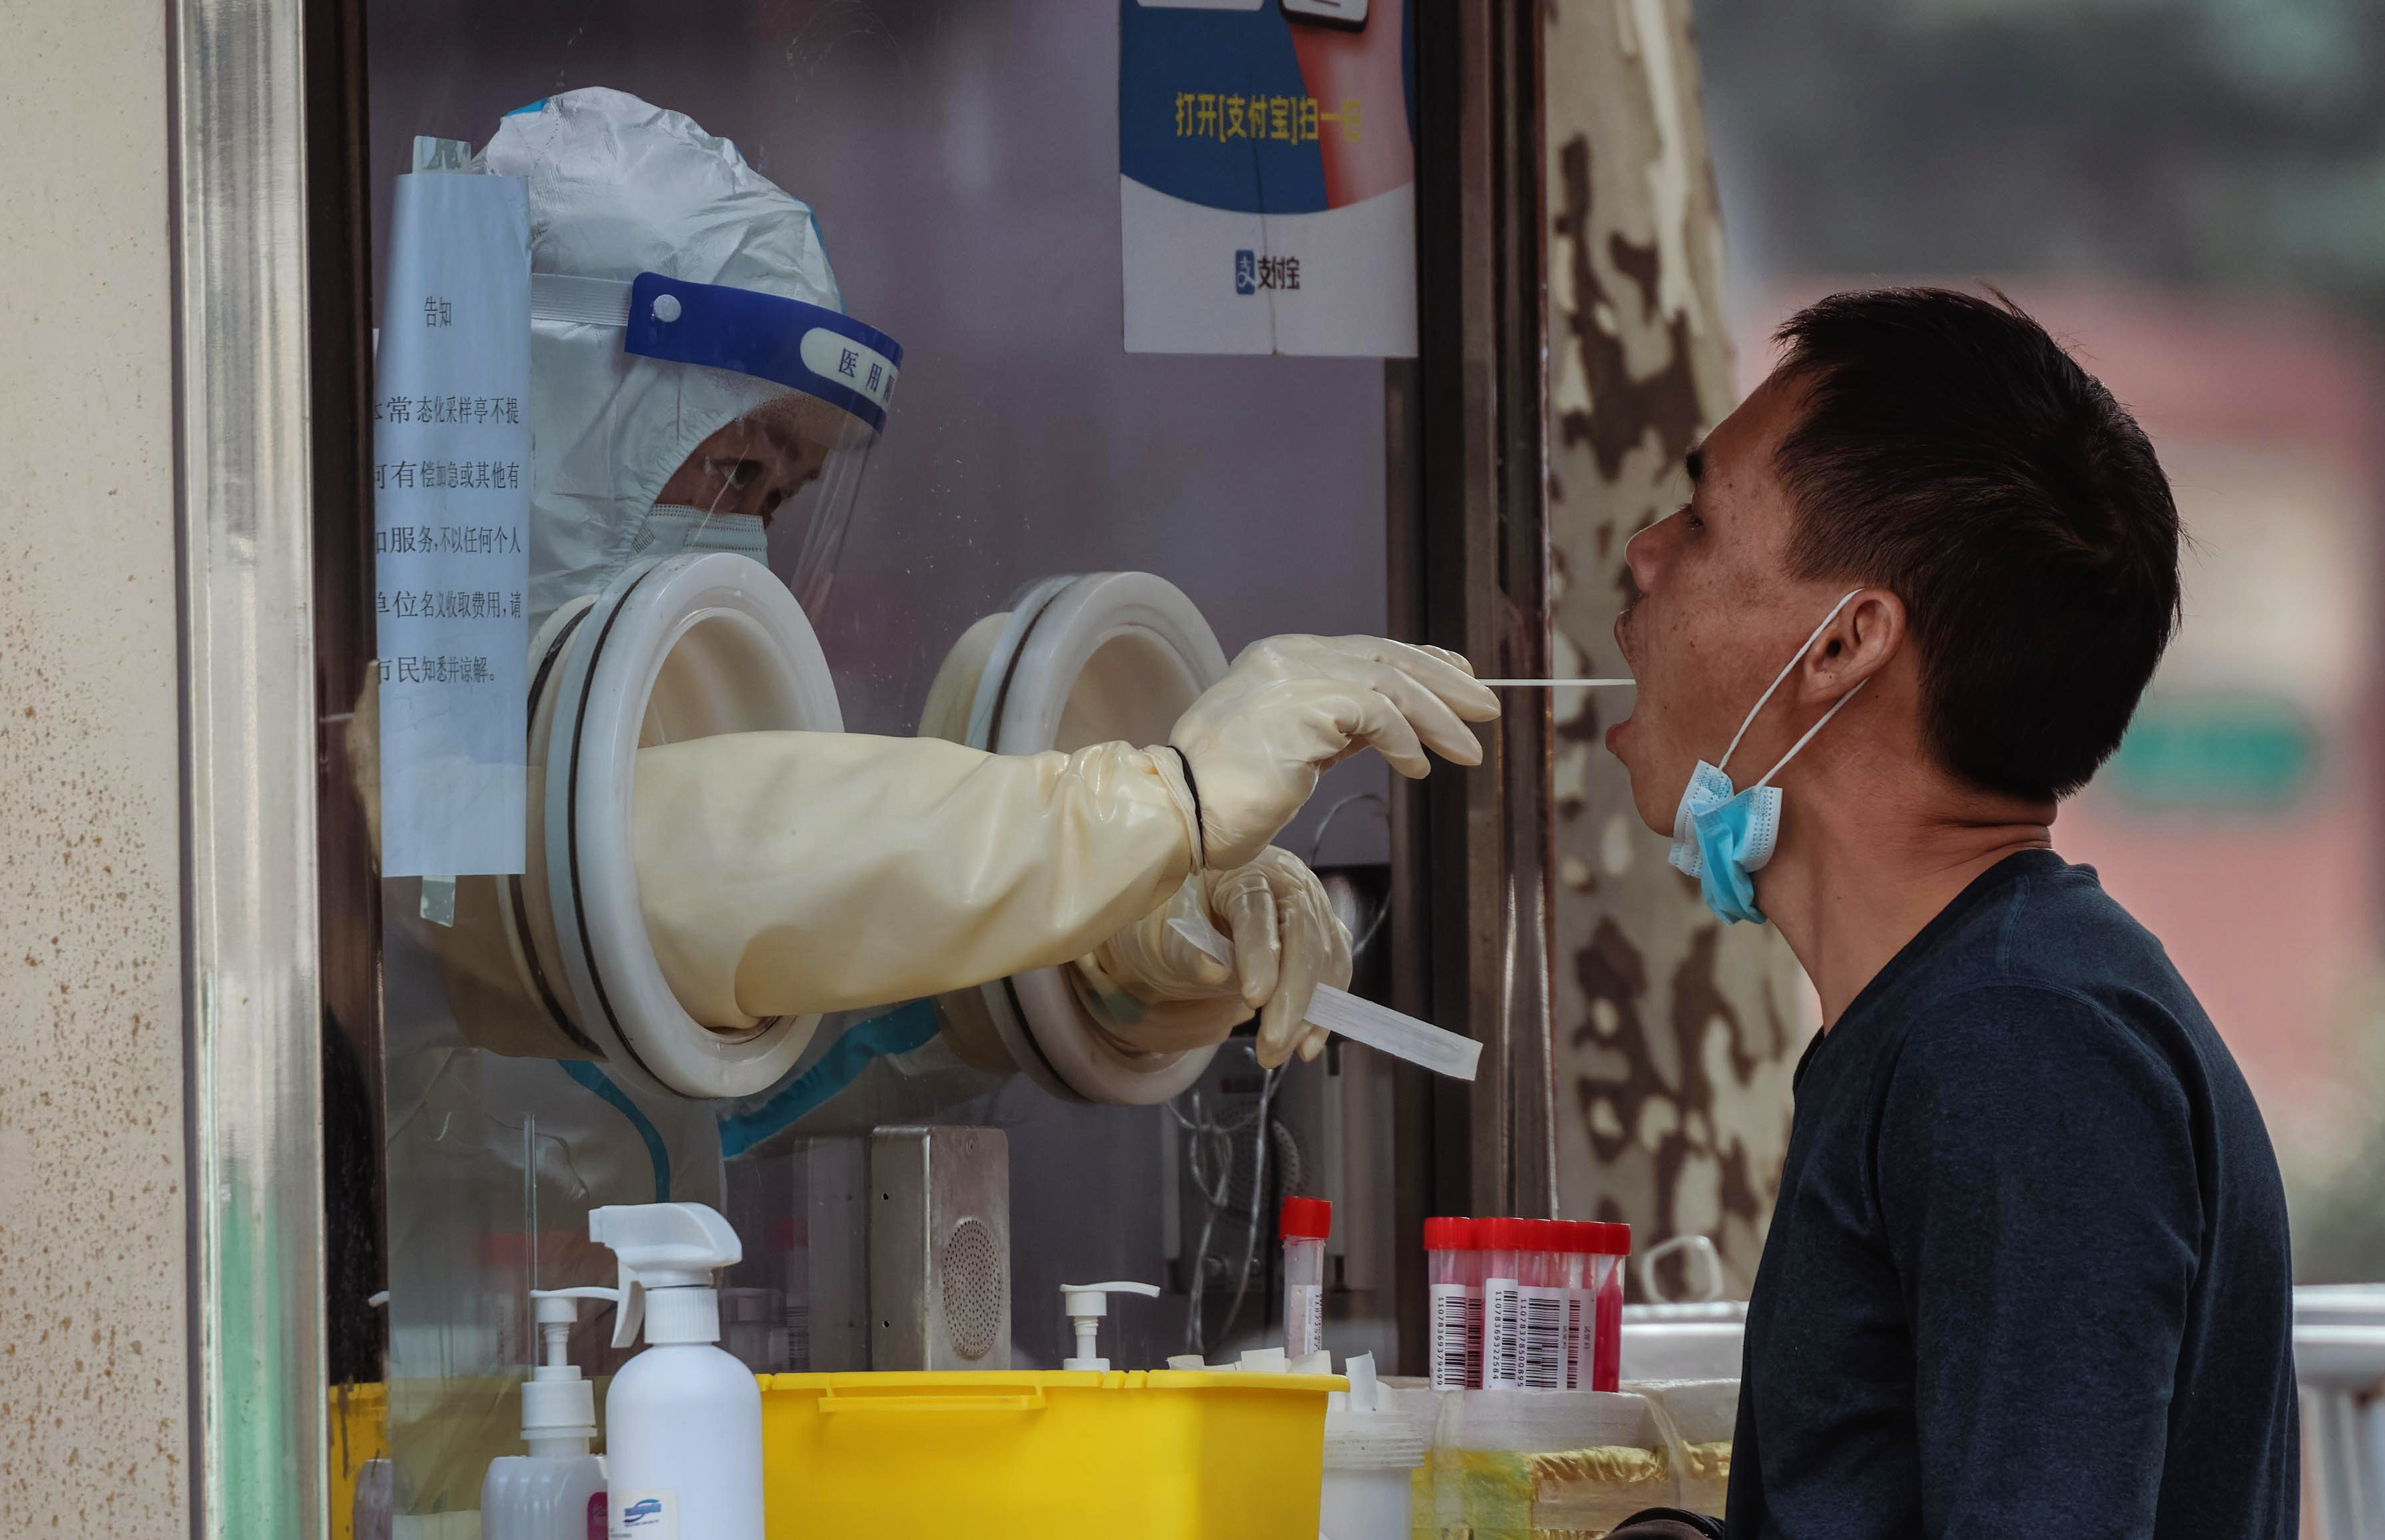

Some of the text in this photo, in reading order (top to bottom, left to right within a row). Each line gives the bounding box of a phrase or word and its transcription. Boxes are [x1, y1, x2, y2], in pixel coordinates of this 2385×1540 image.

[1257, 254, 1300, 289] 支付宝
[424, 296, 451, 328] 告知
[1493, 1291, 1502, 1380] 11078369322584
[1517, 1299, 1527, 1388] 11078378500895
